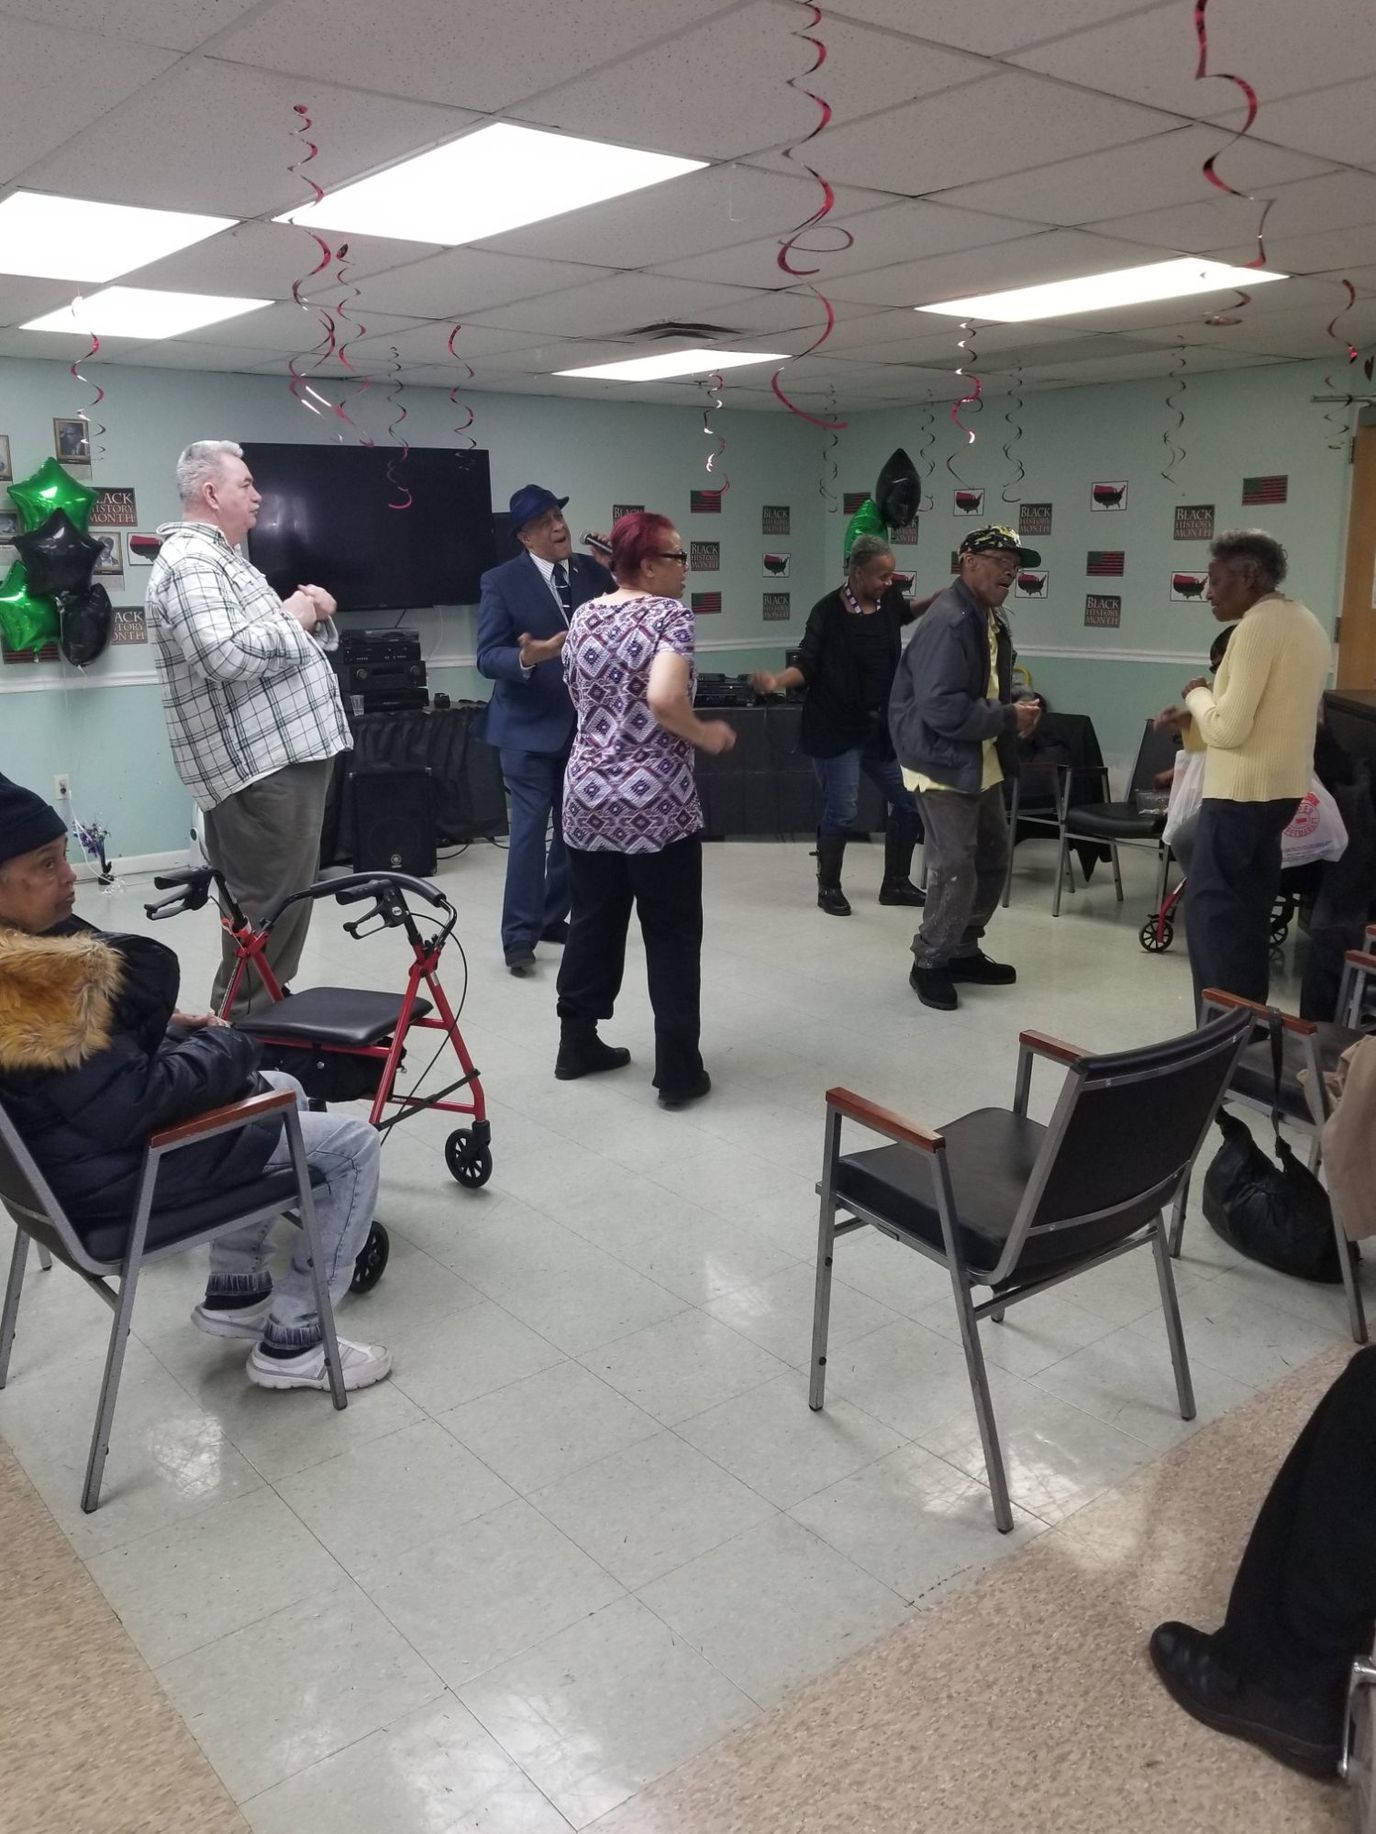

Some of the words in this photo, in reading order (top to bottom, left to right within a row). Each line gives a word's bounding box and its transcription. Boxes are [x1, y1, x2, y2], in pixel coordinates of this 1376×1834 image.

[1021, 506, 1050, 517] BLACK
[1177, 508, 1212, 520] BLACK
[692, 543, 718, 555] BLACK
[1087, 597, 1119, 609] BLACK
